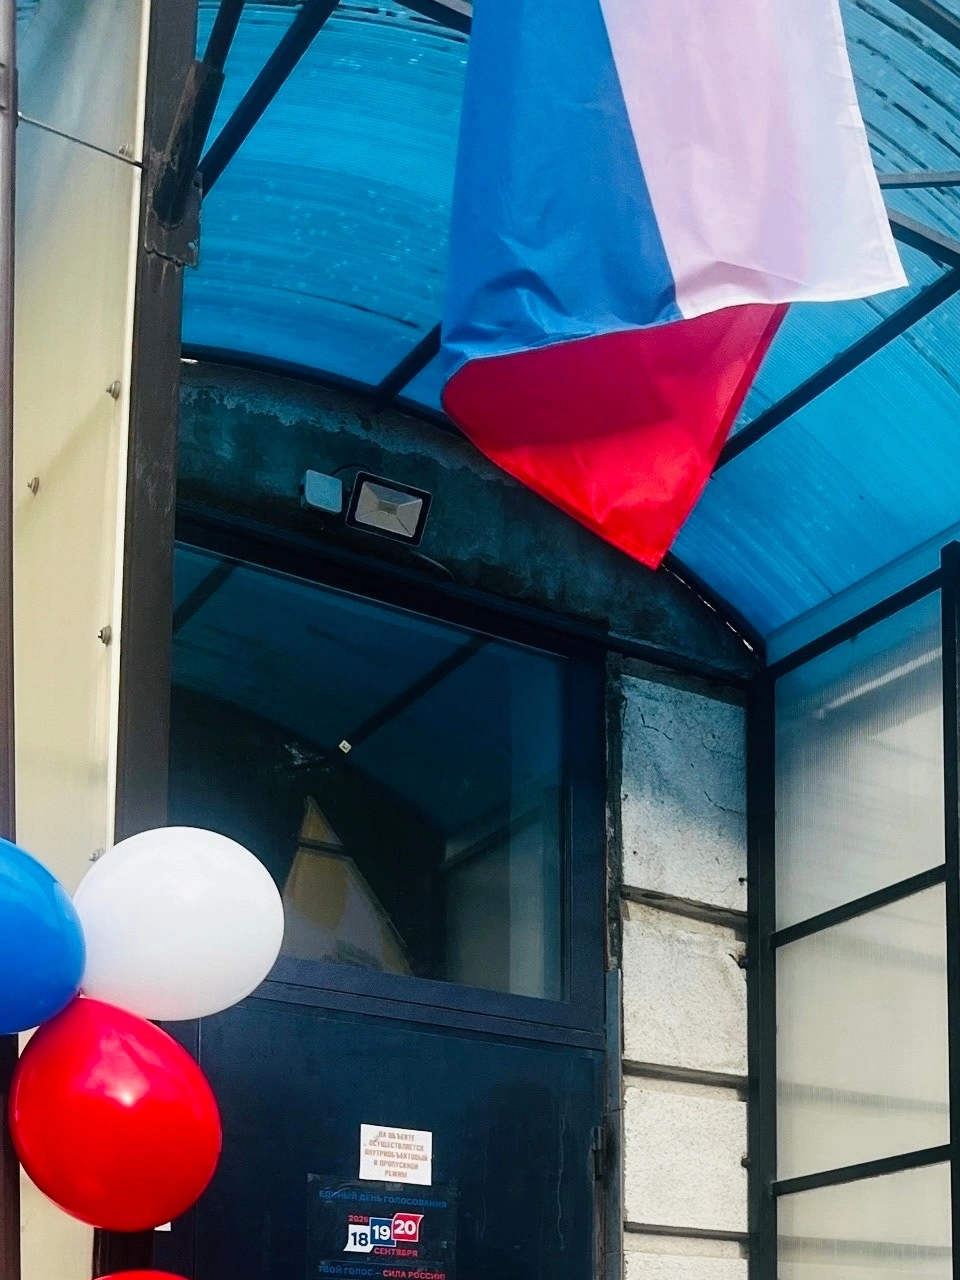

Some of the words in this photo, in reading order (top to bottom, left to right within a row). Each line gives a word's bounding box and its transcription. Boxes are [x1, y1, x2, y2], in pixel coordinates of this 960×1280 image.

[319, 1189, 358, 1201] ЕДИНЫЙ
[360, 1193, 383, 1203] ДЕНЬ
[383, 1196, 448, 1208] ГОЛОСОВАНИЯ
[351, 1232, 369, 1247] 18
[372, 1225, 391, 1240] 19
[394, 1219, 417, 1235] 20
[373, 1247, 418, 1257] СЕНТЯБРЯ
[319, 1264, 342, 1274] ТВОЙ
[344, 1267, 374, 1276] ГОЛОС
[382, 1269, 407, 1279] СИЛА
[408, 1271, 446, 1280] РОССИИ!
